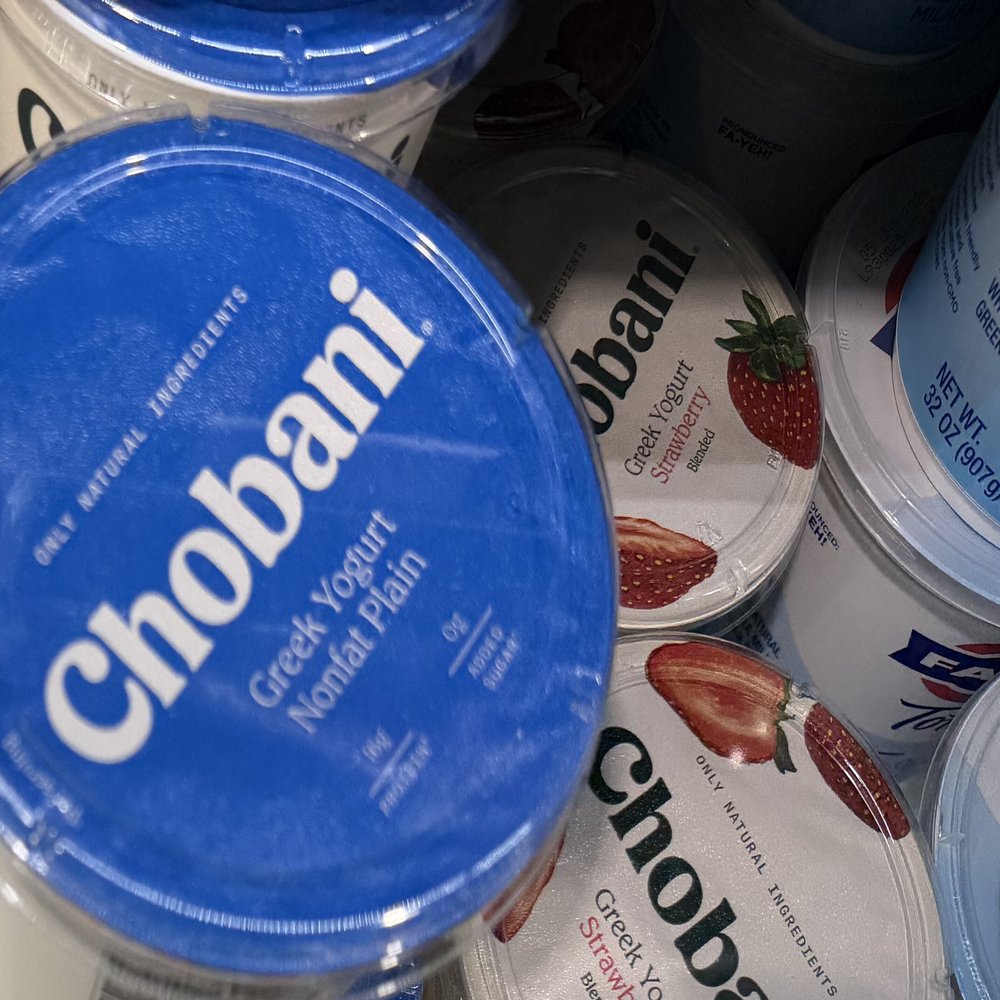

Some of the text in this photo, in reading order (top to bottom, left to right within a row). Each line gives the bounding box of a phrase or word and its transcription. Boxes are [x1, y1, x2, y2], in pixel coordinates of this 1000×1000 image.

[33, 285, 249, 566] ONLY NATURAL INGREDIENTS
[624, 358, 694, 477] Greek Yogurt
[649, 386, 712, 485] Strawberry
[686, 428, 716, 474] Blended
[923, 386, 963, 442] 32 OZ
[935, 361, 988, 442] NET WT.
[43, 267, 426, 765] Chobani
[249, 510, 397, 708] Greek Yogurt
[287, 628, 375, 734] Nonfat
[358, 549, 427, 634] Plain
[595, 888, 644, 969] Greek
[695, 755, 838, 997] ONLY NATURAL INGREDIENTS
